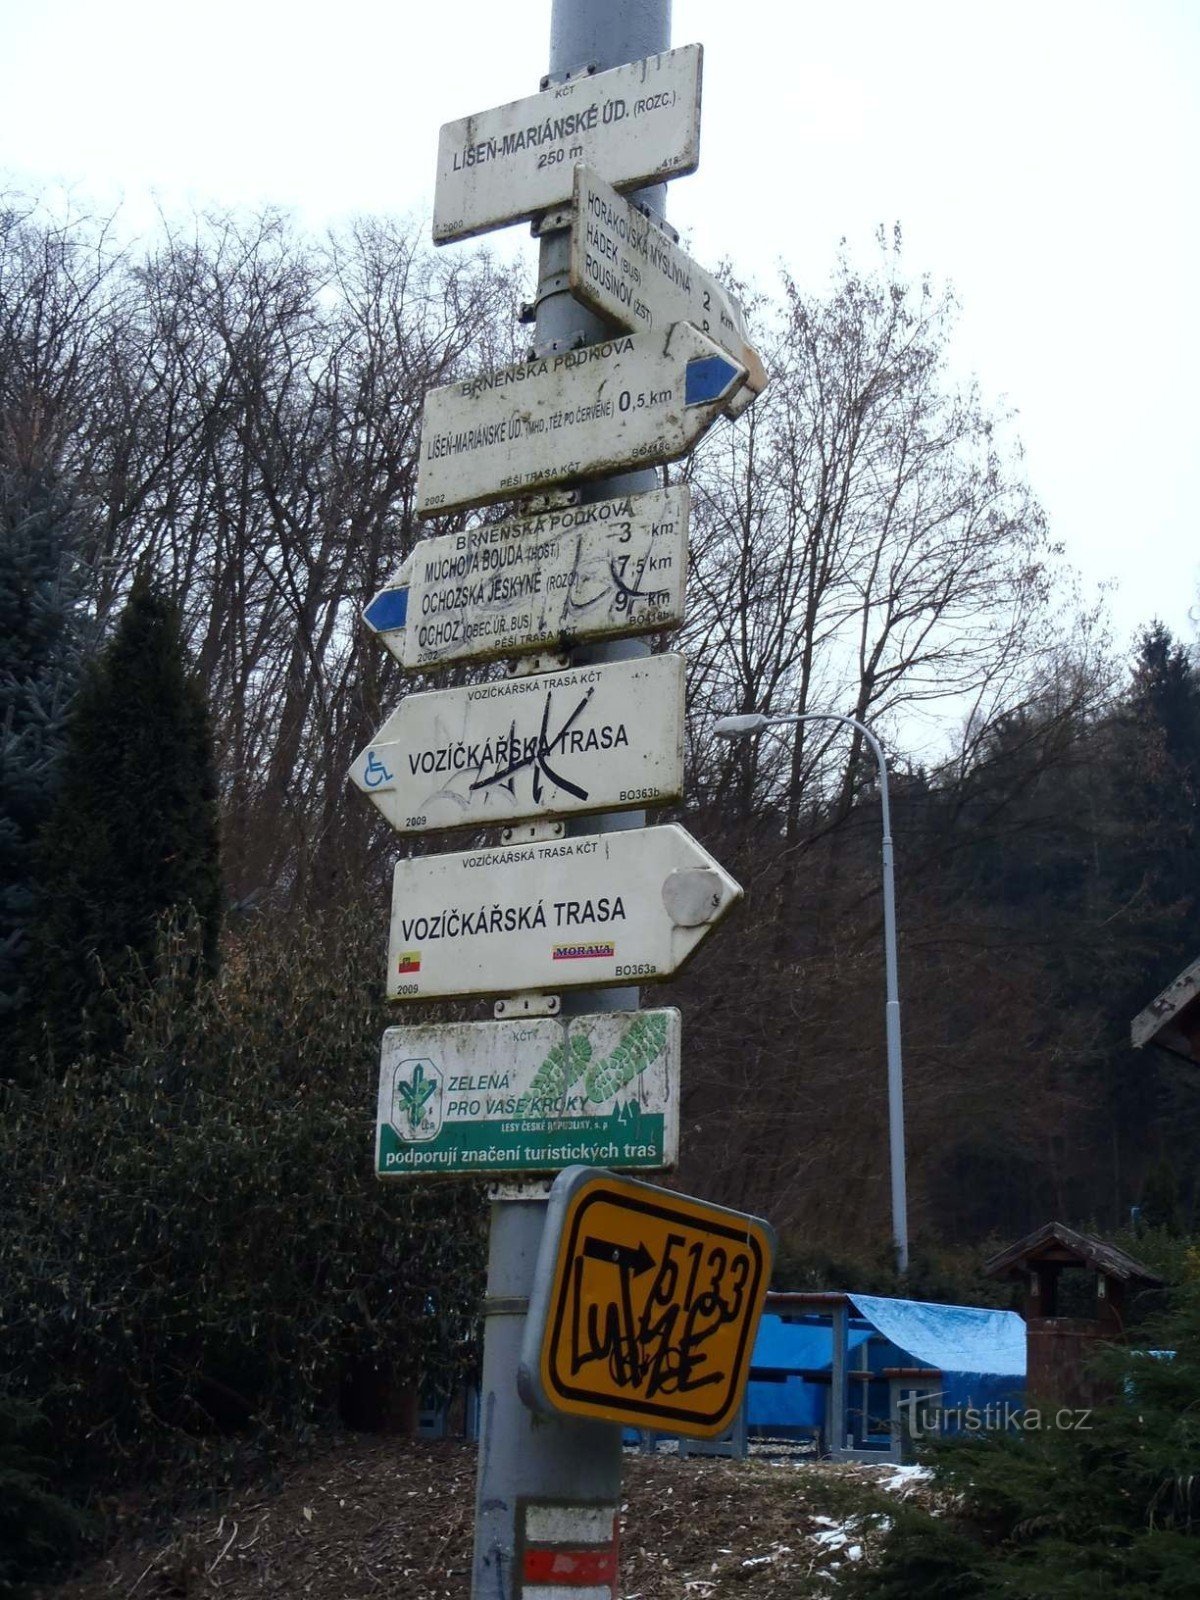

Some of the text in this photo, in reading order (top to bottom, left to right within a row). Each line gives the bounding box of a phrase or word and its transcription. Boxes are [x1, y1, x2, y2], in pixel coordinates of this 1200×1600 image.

[555, 85, 576, 98] KČT
[602, 94, 629, 125] ÚD.
[633, 90, 676, 118] (ROZC.)
[537, 145, 583, 170] 250 m
[586, 221, 618, 266] HÁDEK
[620, 257, 641, 287] (BUS)
[587, 189, 734, 332] HORÁKOVSKÁ MYSLIVNA 2 km
[585, 253, 634, 307] ROUSÍNOV
[554, 337, 636, 372] PODKOVA
[563, 411, 575, 426] PO
[619, 390, 645, 412] 0,5
[650, 389, 672, 405] km
[525, 467, 558, 483] TRASA
[560, 461, 582, 475] KČT
[424, 493, 446, 507] 2002
[551, 501, 635, 531] PODKOVA
[425, 550, 479, 583] MUCHOVA
[482, 544, 524, 571] BOUDA
[619, 521, 632, 543] 3
[651, 522, 674, 537] km
[421, 578, 485, 616] OCHOZSKÁ
[488, 566, 542, 602] JESKYNĚ
[618, 554, 645, 577] 7,5
[649, 556, 672, 571] km
[418, 619, 460, 648] OCHOZ
[511, 612, 532, 632] BUS)
[615, 591, 629, 612] 9
[648, 591, 670, 607] km
[495, 635, 517, 648] PĚŠÍ
[521, 630, 556, 645] TRASA
[417, 650, 439, 664] 2002
[468, 671, 602, 701] VOZÍČKÁŘSKÁ TRASA KČT
[557, 724, 629, 755] TRASA
[619, 788, 660, 801] BO363b
[405, 816, 427, 828] 2009
[462, 842, 598, 869] VOZÍČKÁŘSKÁ TRASA KČT
[402, 896, 627, 942] VOZÍČKÁŘSKÁ TRASA
[555, 943, 611, 957] MORAVA
[615, 963, 657, 977] BO363a
[397, 984, 419, 995] 2009
[511, 1030, 533, 1042] KČT
[447, 1072, 510, 1092] ZELENÁ
[447, 1095, 590, 1116] PRO VAŠE KROKY
[501, 1122, 520, 1133] LESY
[521, 1120, 547, 1132] ČESKÉ
[386, 1142, 657, 1166] podporují značení turistických tras
[653, 1233, 750, 1323] 5133
